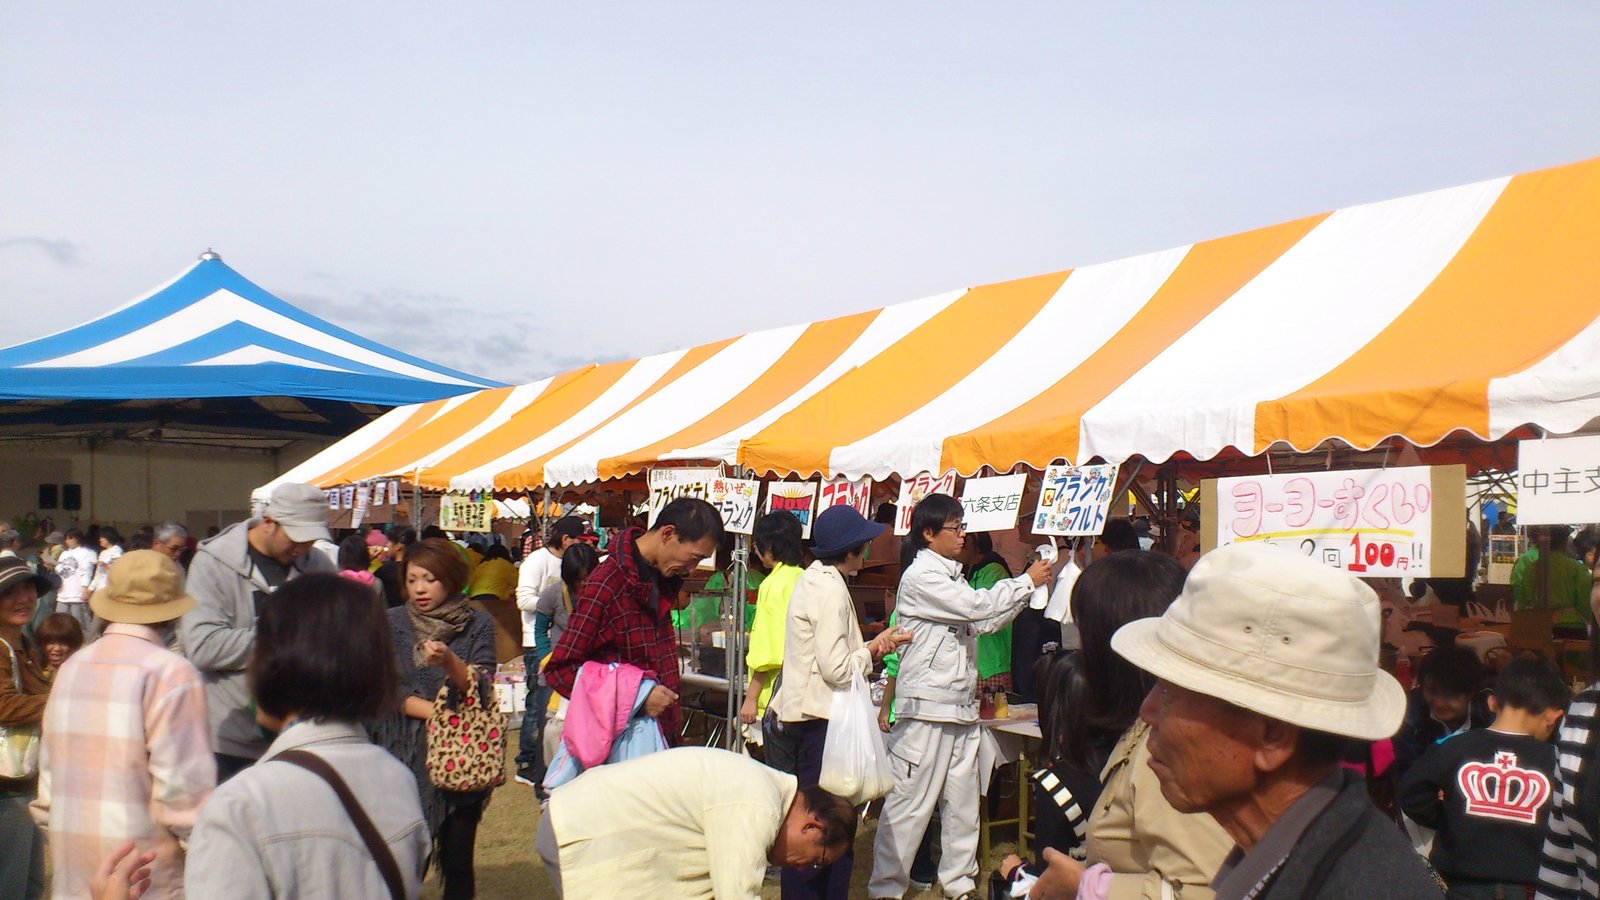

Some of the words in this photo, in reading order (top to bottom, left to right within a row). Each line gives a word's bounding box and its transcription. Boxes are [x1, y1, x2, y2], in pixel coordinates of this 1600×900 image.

[713, 480, 746, 496] 熱いぜ
[1054, 475, 1108, 502] フランク
[771, 494, 812, 510] NOW
[963, 493, 1020, 514] 六条支店
[713, 501, 753, 529] フランク
[1068, 504, 1104, 532] フルト
